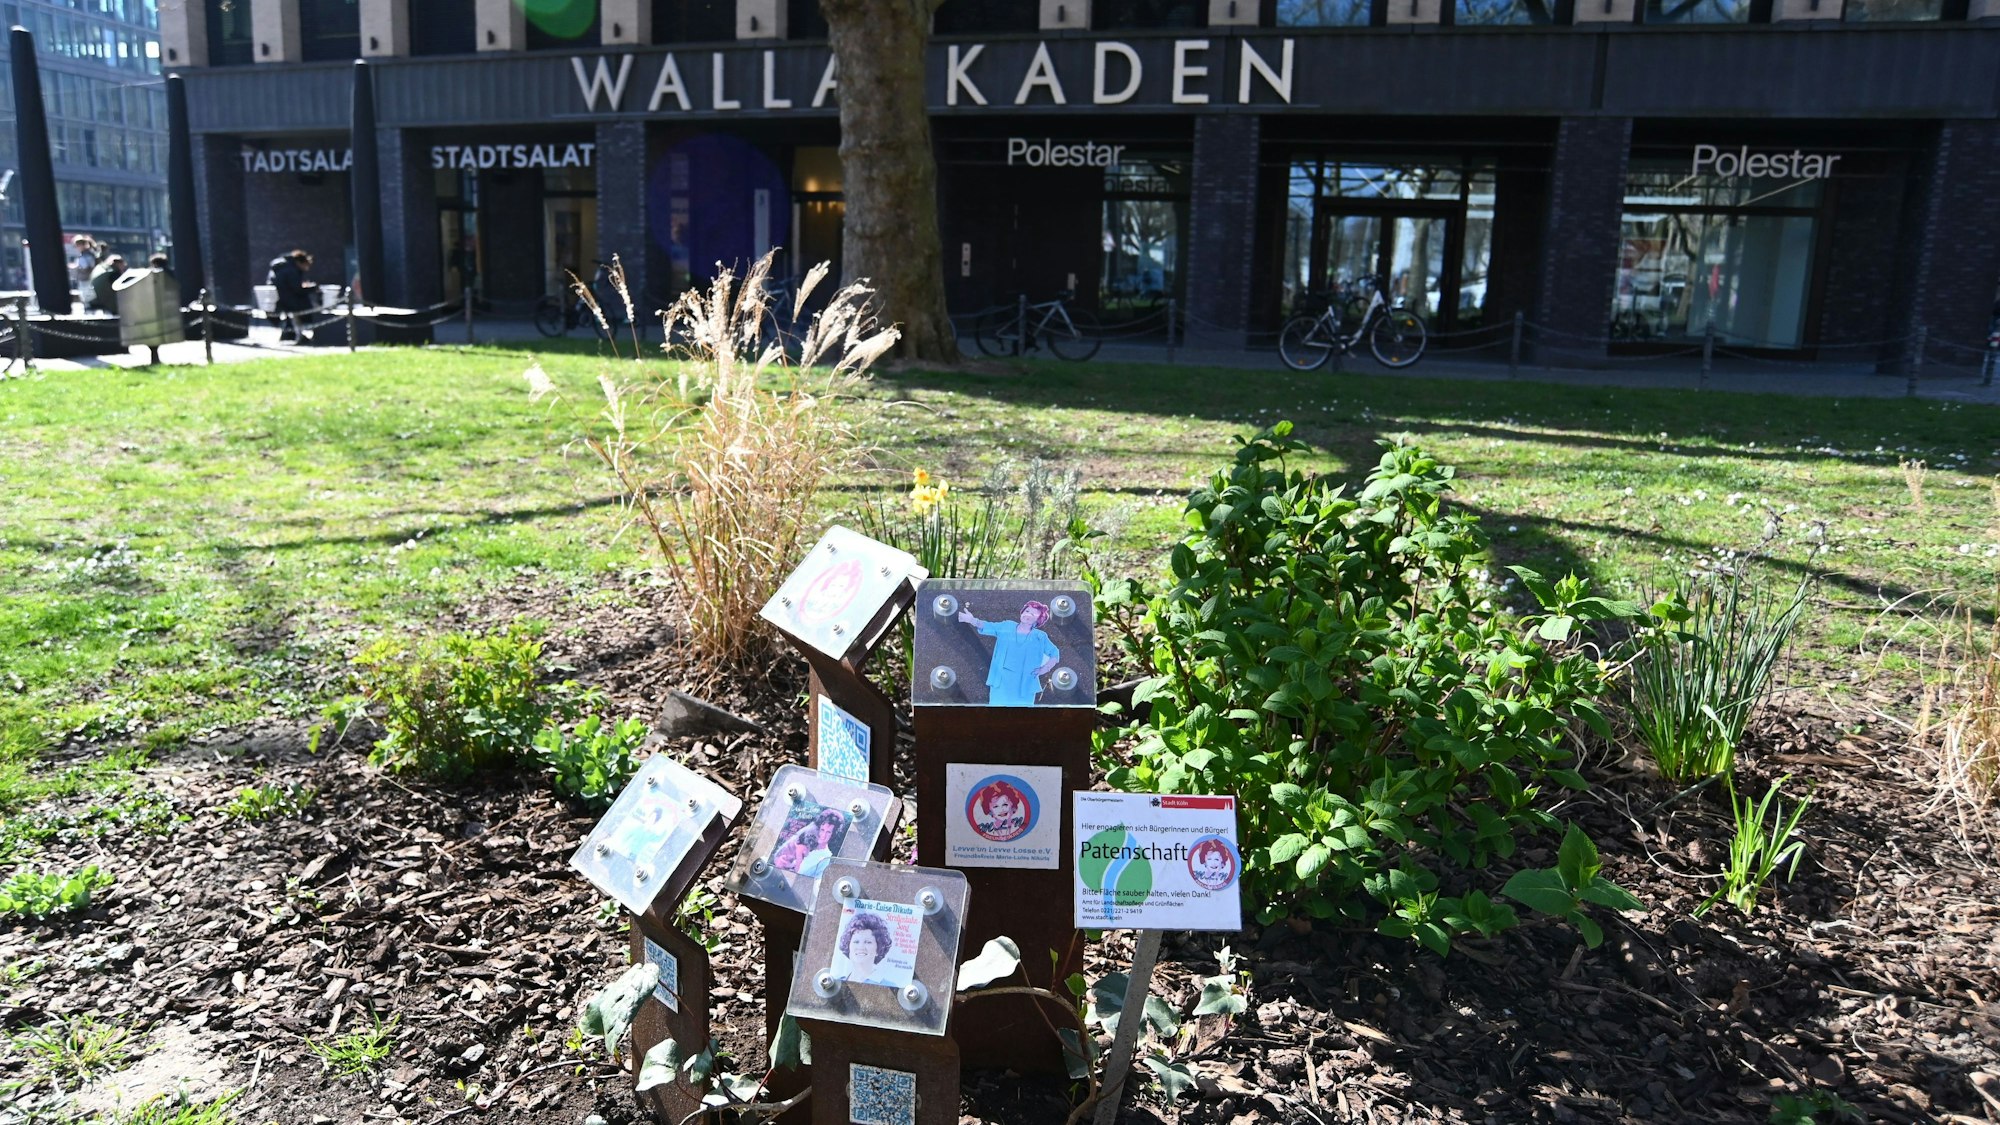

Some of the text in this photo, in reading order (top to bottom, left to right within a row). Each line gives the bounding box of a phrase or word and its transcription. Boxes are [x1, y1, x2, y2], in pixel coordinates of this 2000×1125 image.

[431, 143, 596, 169] STADTSALAT
[1007, 138, 1126, 167] Polestar
[1692, 144, 1842, 178] Polestar
[1096, 823, 1134, 833] engagieren
[1149, 825, 1190, 833] Bürgerinnen
[1204, 827, 1229, 835] Bürger!
[1080, 841, 1189, 861] Patenschaft
[1082, 888, 1099, 896] Bitte
[1099, 888, 1121, 897] Fläche
[1122, 889, 1145, 897] sauber
[1146, 889, 1169, 898] halten,
[1191, 890, 1211, 898] Dank!
